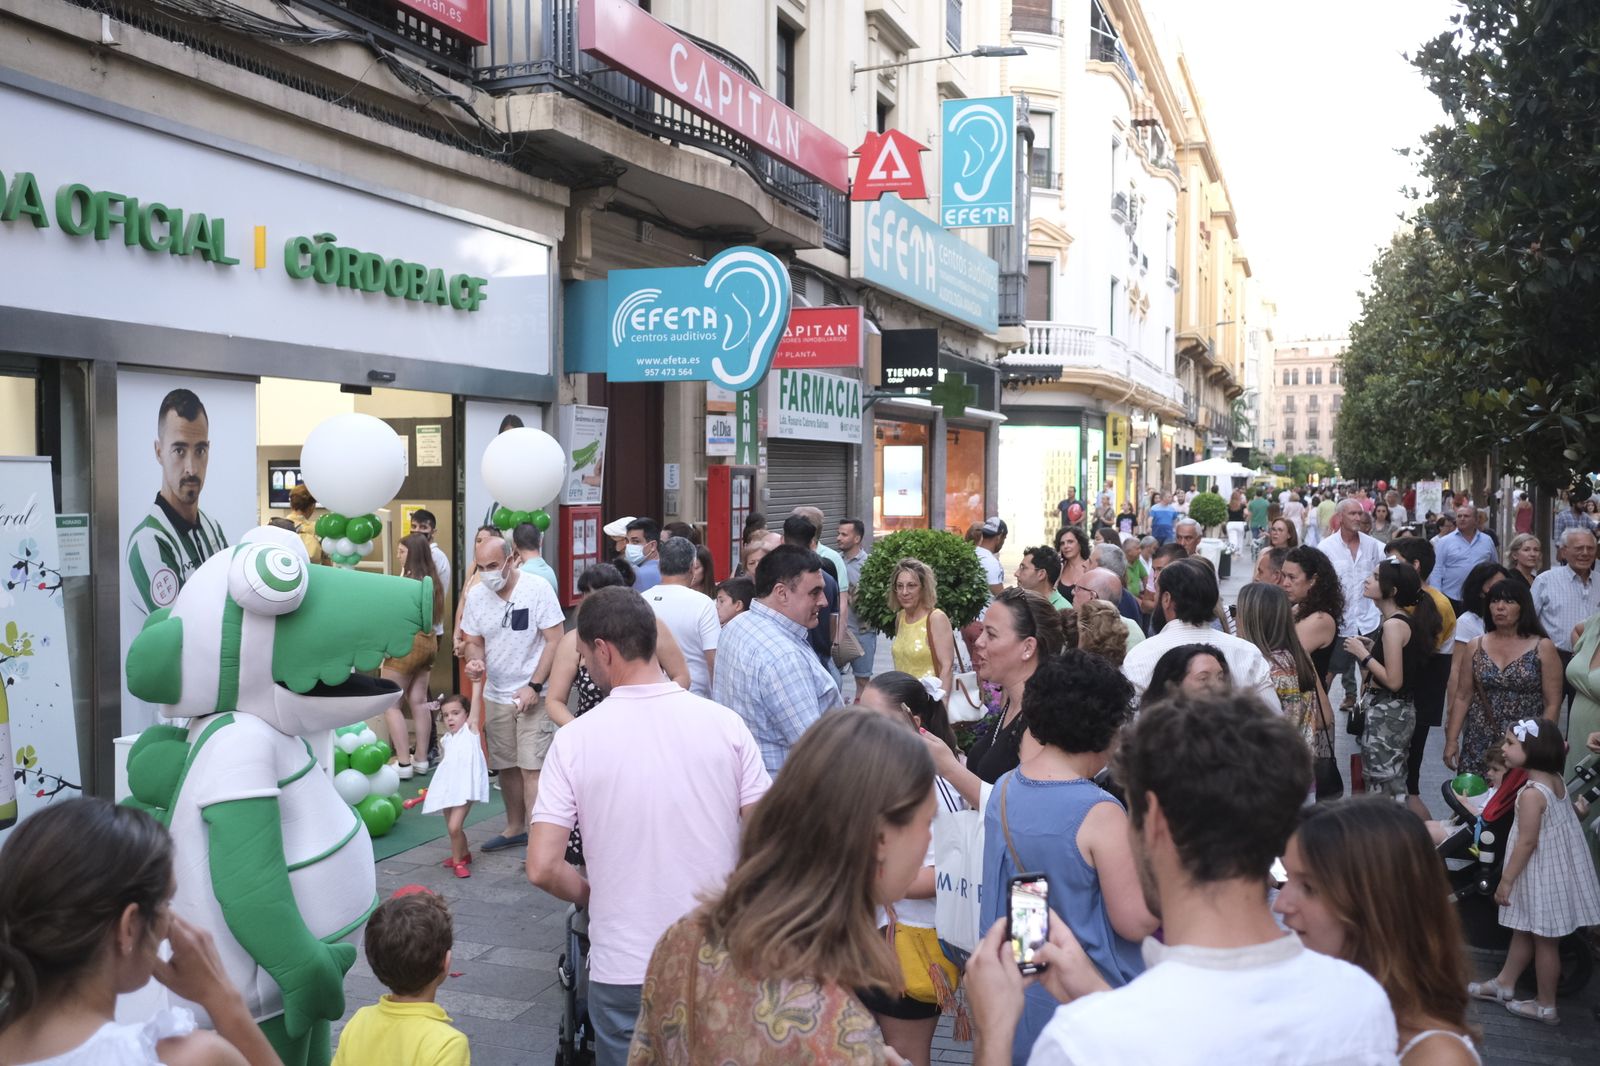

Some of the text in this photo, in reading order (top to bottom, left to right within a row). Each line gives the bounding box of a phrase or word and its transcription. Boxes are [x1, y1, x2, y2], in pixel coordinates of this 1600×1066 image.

[670, 42, 800, 160] CAPITAN
[0, 171, 240, 266] A OFICIAL
[944, 206, 1010, 226] EFETA
[867, 199, 936, 293] EFETA
[284, 232, 488, 312] CÓRDOBA CF
[630, 305, 718, 331] EFETA
[630, 330, 718, 343] centros auditivos
[636, 355, 701, 366] www.efeta.es
[644, 367, 693, 377] 957 473 564
[886, 367, 934, 378] TIENDAS
[780, 369, 861, 420] FARMACIA
[712, 420, 732, 437] el Día
